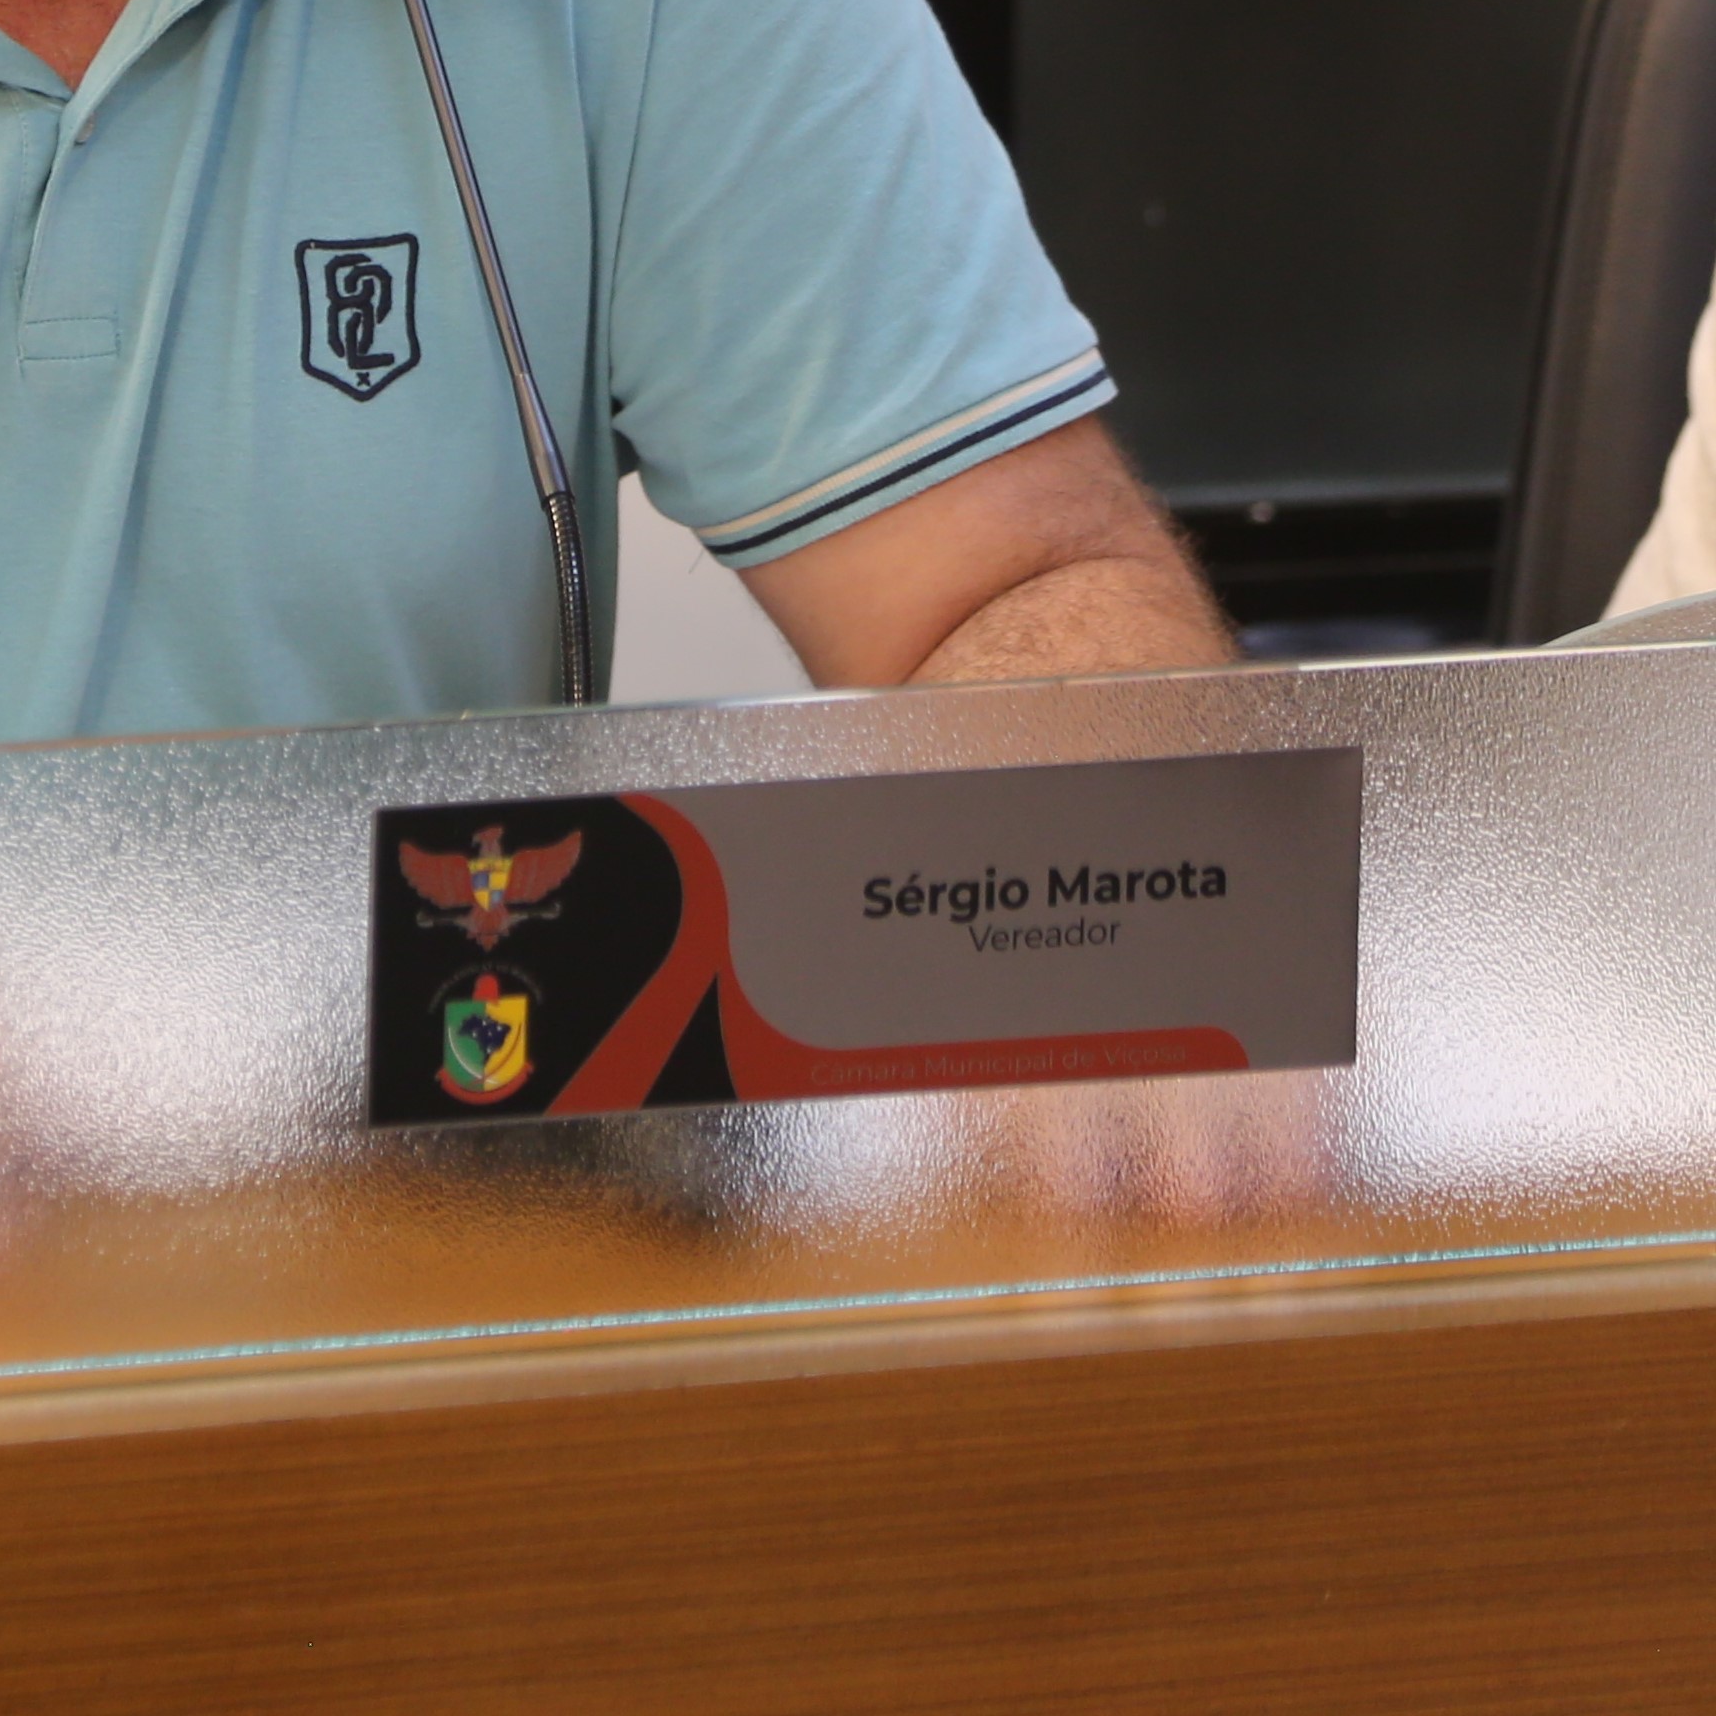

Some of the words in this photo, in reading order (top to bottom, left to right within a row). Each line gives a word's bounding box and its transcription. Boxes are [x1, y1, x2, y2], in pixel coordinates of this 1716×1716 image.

[862, 867, 1030, 924] Sérgio
[1047, 859, 1227, 908] Marota
[968, 917, 1121, 953] Vereador
[924, 1046, 1055, 1079] Municipal
[1062, 1046, 1097, 1069] de
